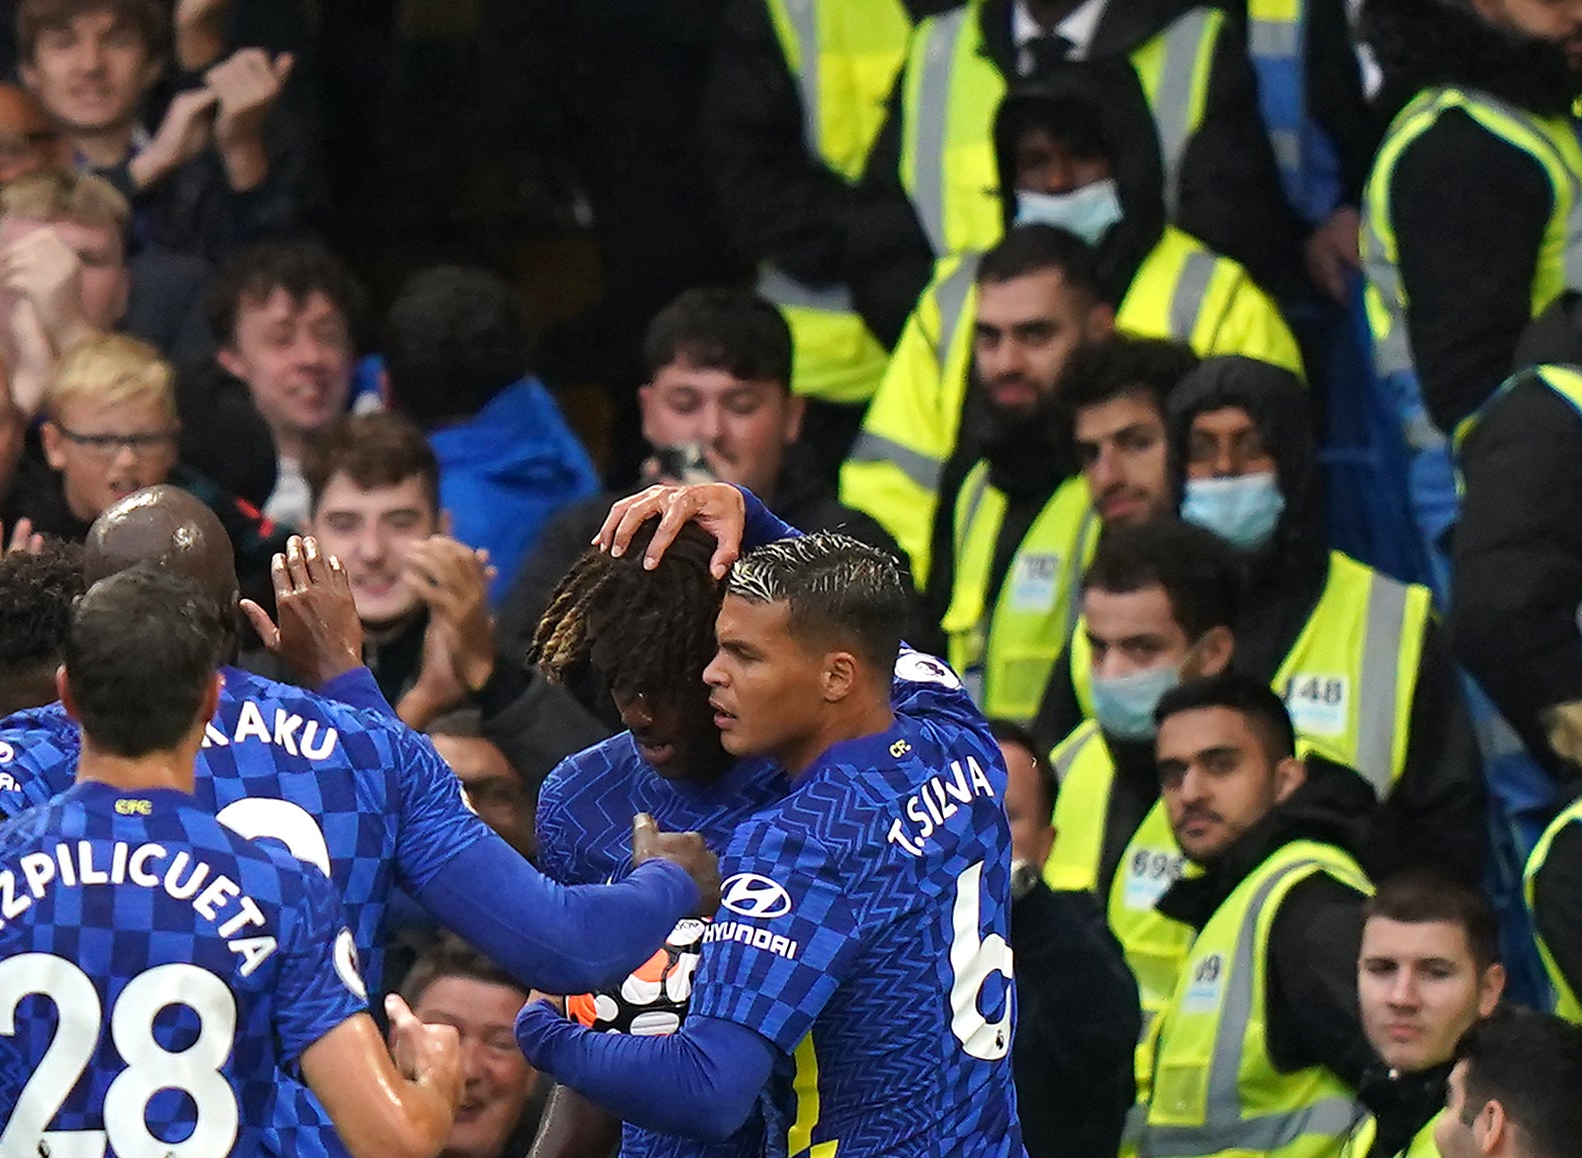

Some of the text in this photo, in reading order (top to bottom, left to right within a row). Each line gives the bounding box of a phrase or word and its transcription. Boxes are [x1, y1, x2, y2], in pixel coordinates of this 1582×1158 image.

[887, 755, 995, 857] T.SILVA
[703, 920, 798, 960] HYUNDAI
[949, 859, 1014, 1060] 6
